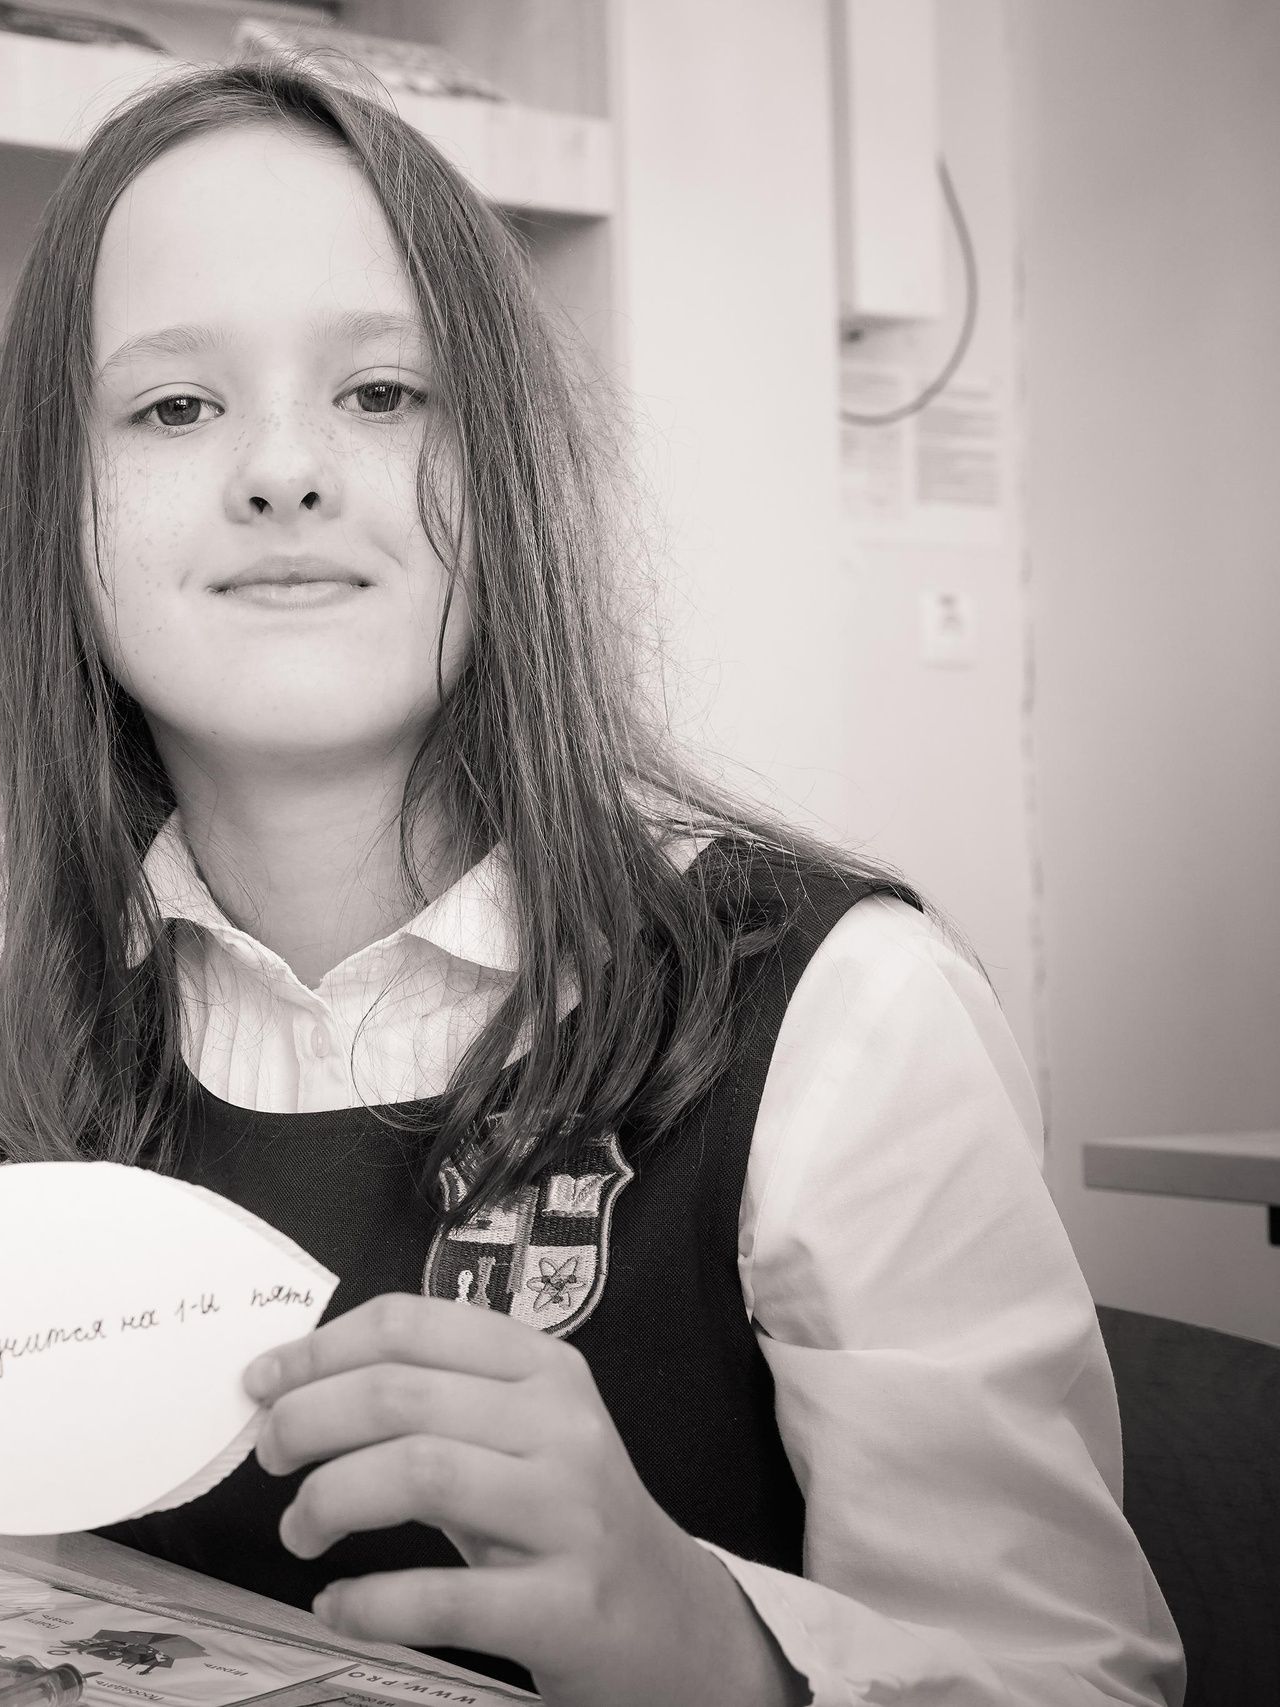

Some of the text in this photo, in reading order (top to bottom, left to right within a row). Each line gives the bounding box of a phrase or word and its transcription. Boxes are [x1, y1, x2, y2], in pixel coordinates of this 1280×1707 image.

[121, 1309, 160, 1331] на
[250, 1284, 315, 1308] пять
[203, 1662, 249, 1677] Играть
[95, 1679, 165, 1701] Пообедать
